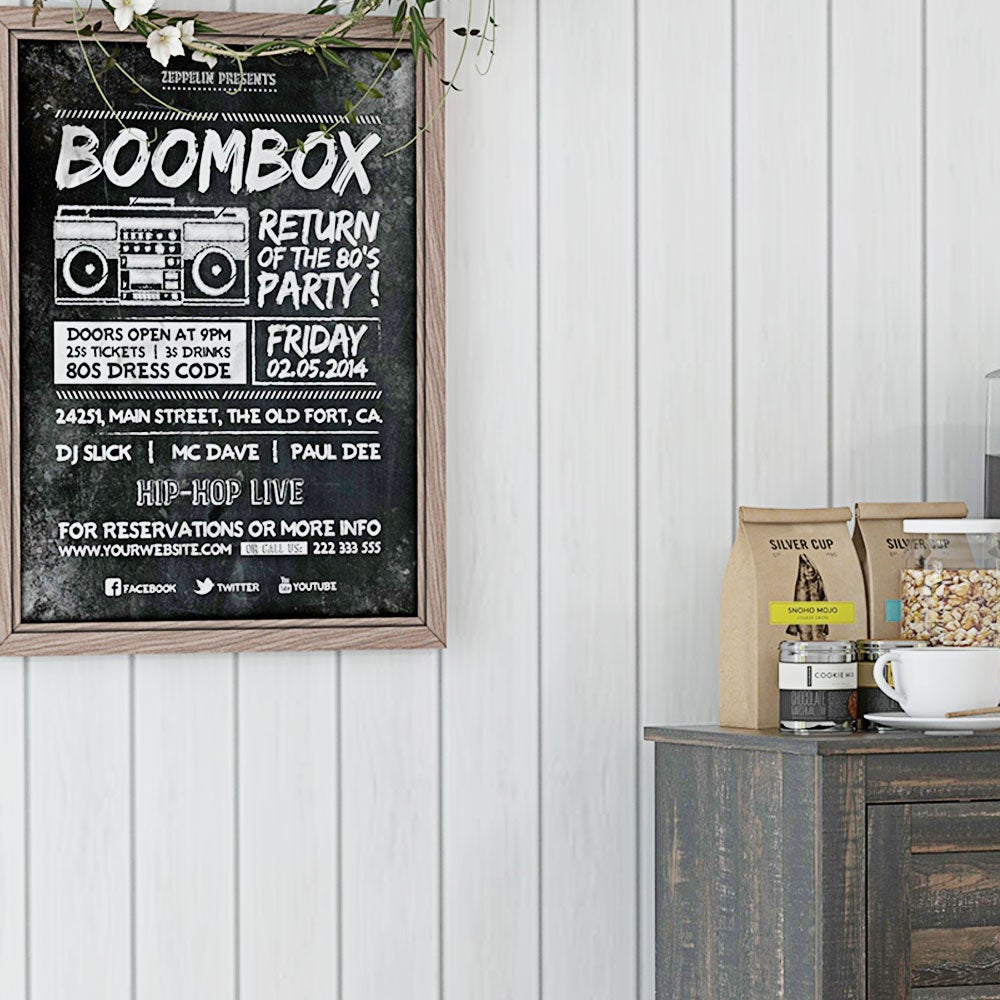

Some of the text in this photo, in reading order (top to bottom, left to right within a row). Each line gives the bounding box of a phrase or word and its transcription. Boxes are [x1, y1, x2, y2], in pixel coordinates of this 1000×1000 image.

[161, 71, 277, 86] ZEPPELIN PRESENTS
[54, 125, 382, 196] BOOMBOX
[257, 209, 381, 246] RETURN
[257, 245, 381, 271] OF THE 80'S
[257, 271, 381, 311] PARTY !
[67, 327, 231, 342] DOORS OPEN AT 9PM
[266, 323, 369, 358] FRIDAY
[91, 346, 146, 358] TICKETS
[182, 346, 231, 358] DRINKS
[66, 362, 231, 379] 80S DRESS CODE
[266, 357, 369, 379] 02.05.2014
[56, 408, 383, 427] 24251, MAIN STREET, THE OLD FORT, CA.
[56, 443, 382, 465] DJ SLICK MC DAVE PAUL DEE
[136, 479, 305, 506] HIP-HOP LIVE
[58, 519, 382, 539] FOR RESERVATIONS OR MORE INFO
[58, 543, 232, 557] WWW.YOURWEBSITE.COM
[245, 544, 258, 553] OR
[262, 543, 284, 554] CALL
[313, 542, 336, 555] 222
[338, 541, 359, 554] 333
[361, 541, 382, 554] 555
[769, 539, 834, 550] SILVER CUP
[123, 583, 177, 594] FACEBOOK
[217, 582, 260, 592] TWITTER
[293, 581, 338, 591] YOUTUBE
